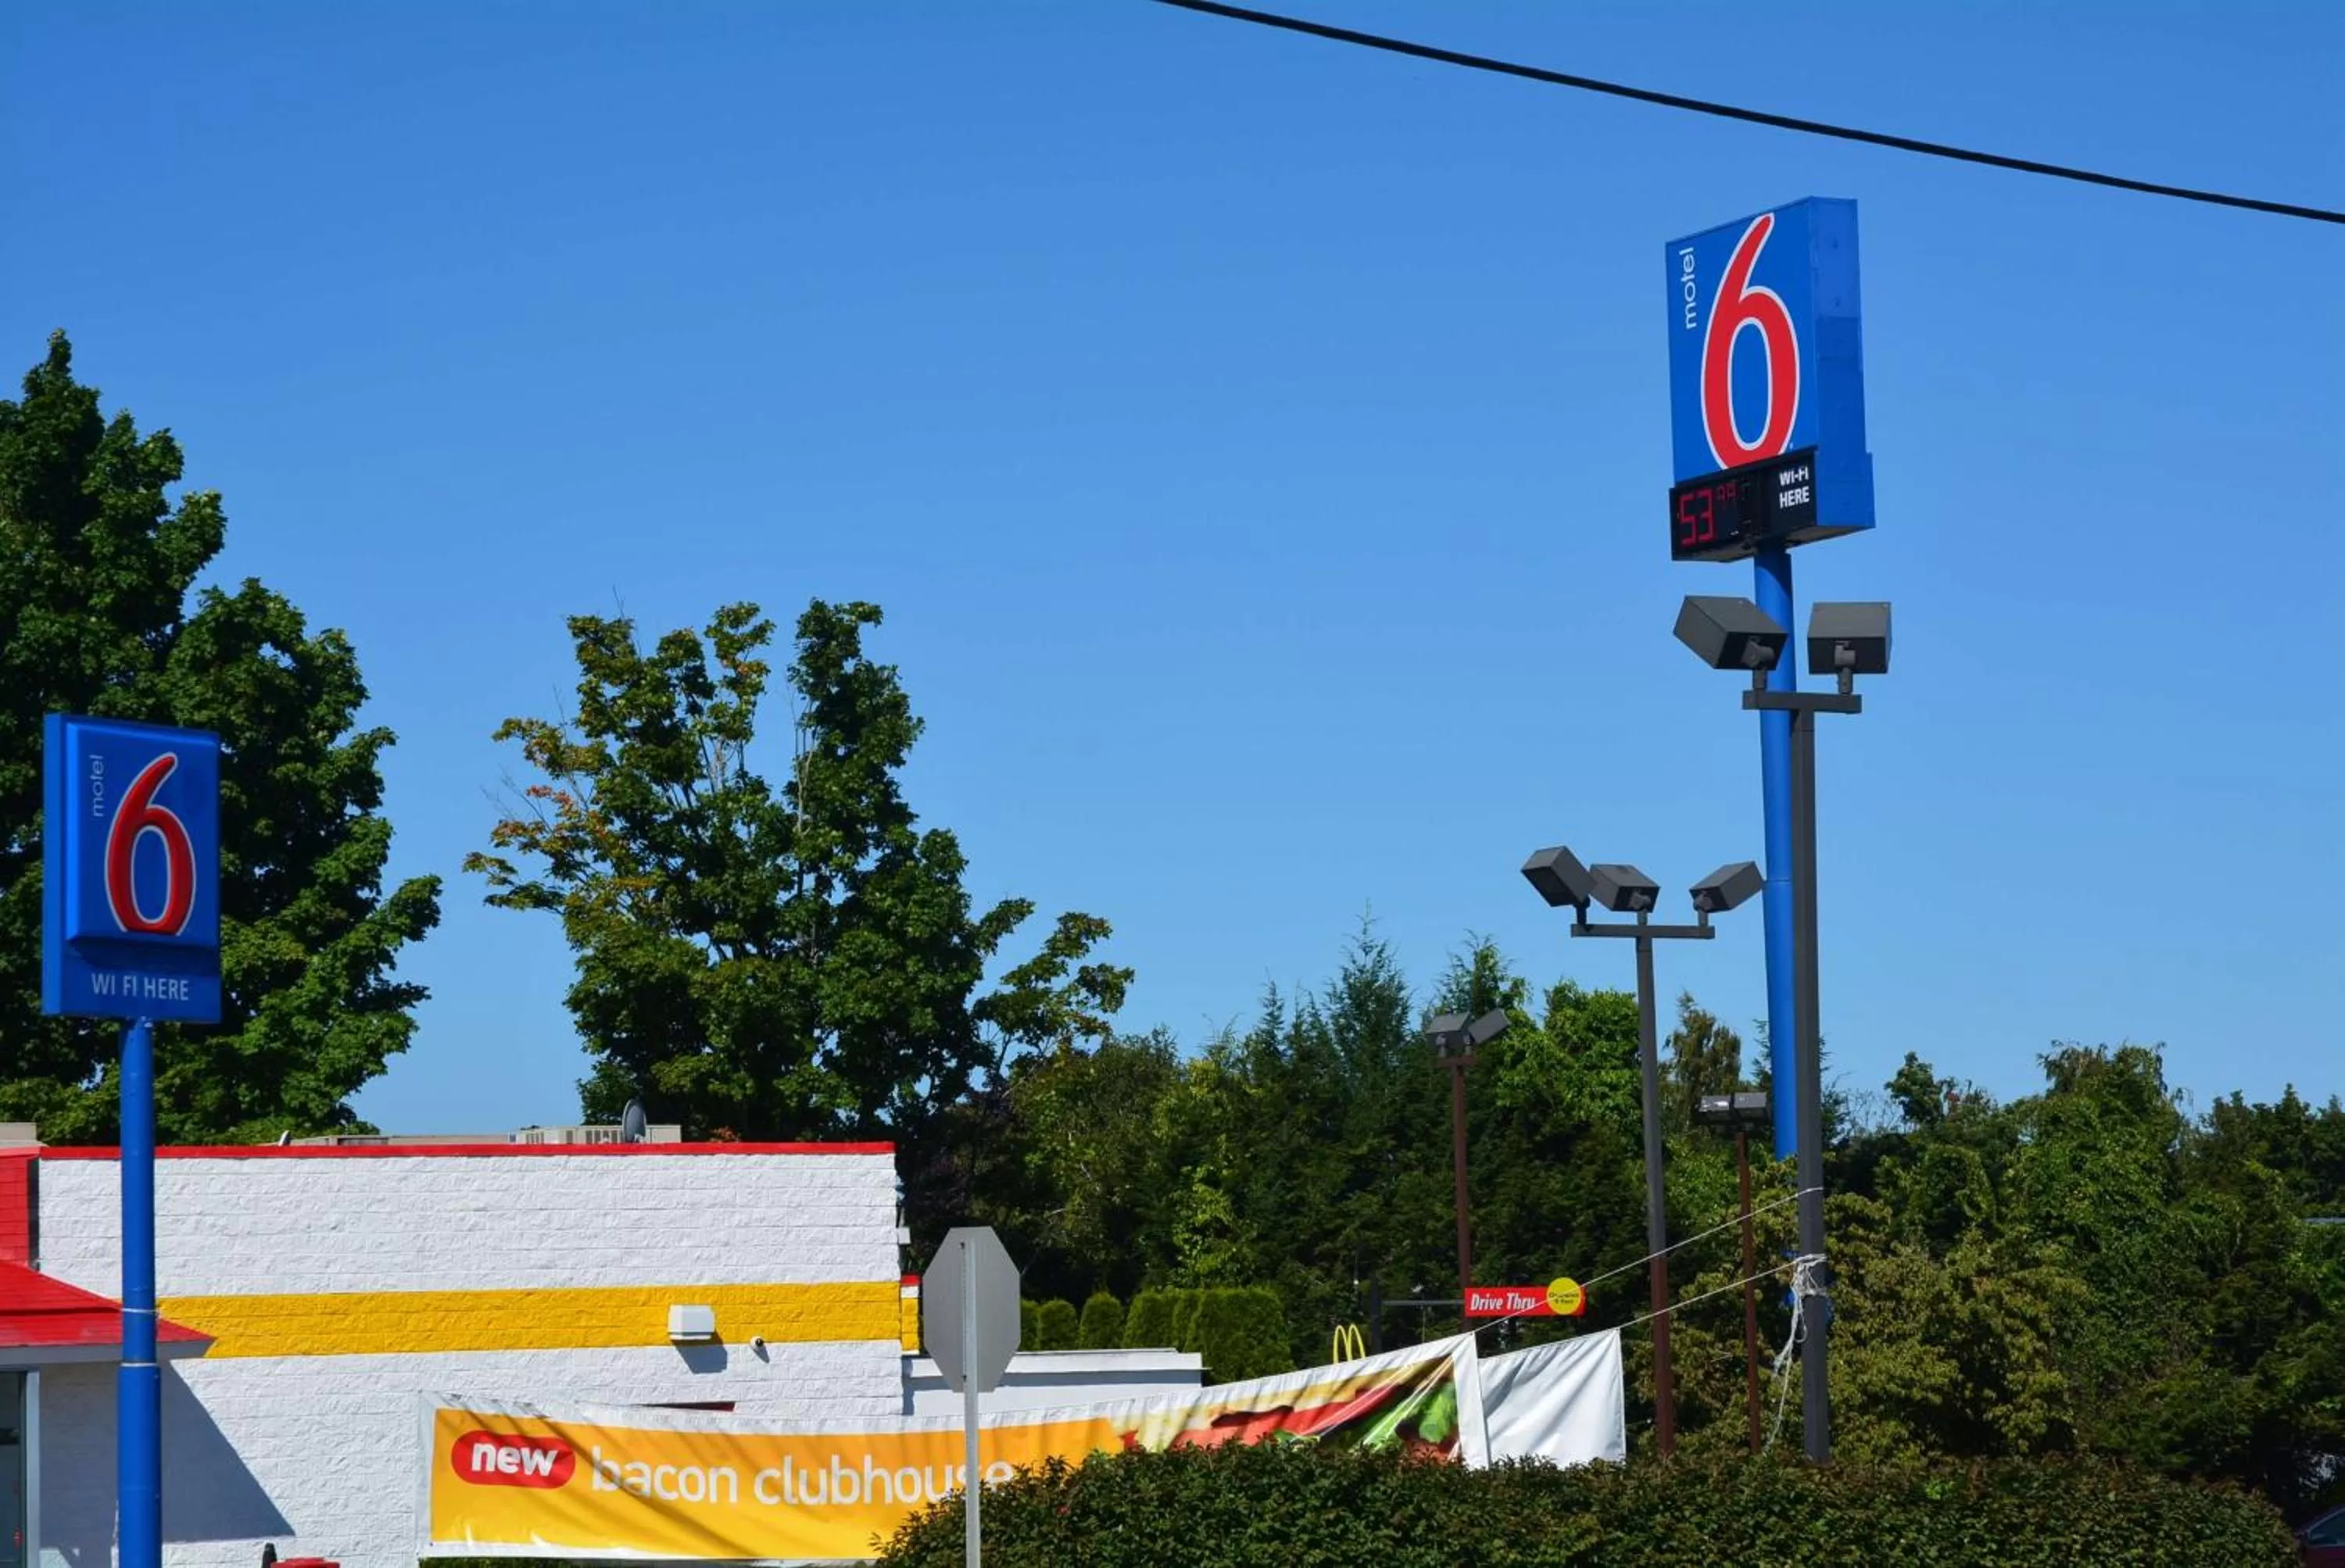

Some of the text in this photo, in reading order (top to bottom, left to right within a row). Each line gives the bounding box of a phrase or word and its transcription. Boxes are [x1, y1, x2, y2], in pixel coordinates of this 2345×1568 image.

[1678, 212, 1800, 470] motel 6
[1778, 466, 1810, 486] WI-FI
[1778, 485, 1810, 509] HERE
[1679, 488, 1714, 546] 53
[89, 751, 197, 936] motel 6
[91, 972, 189, 1001] WI FI HERE
[1470, 1293, 1503, 1311] Drive
[1505, 1292, 1536, 1311] Thru
[471, 1443, 559, 1477] new
[592, 1444, 739, 1504] bacon
